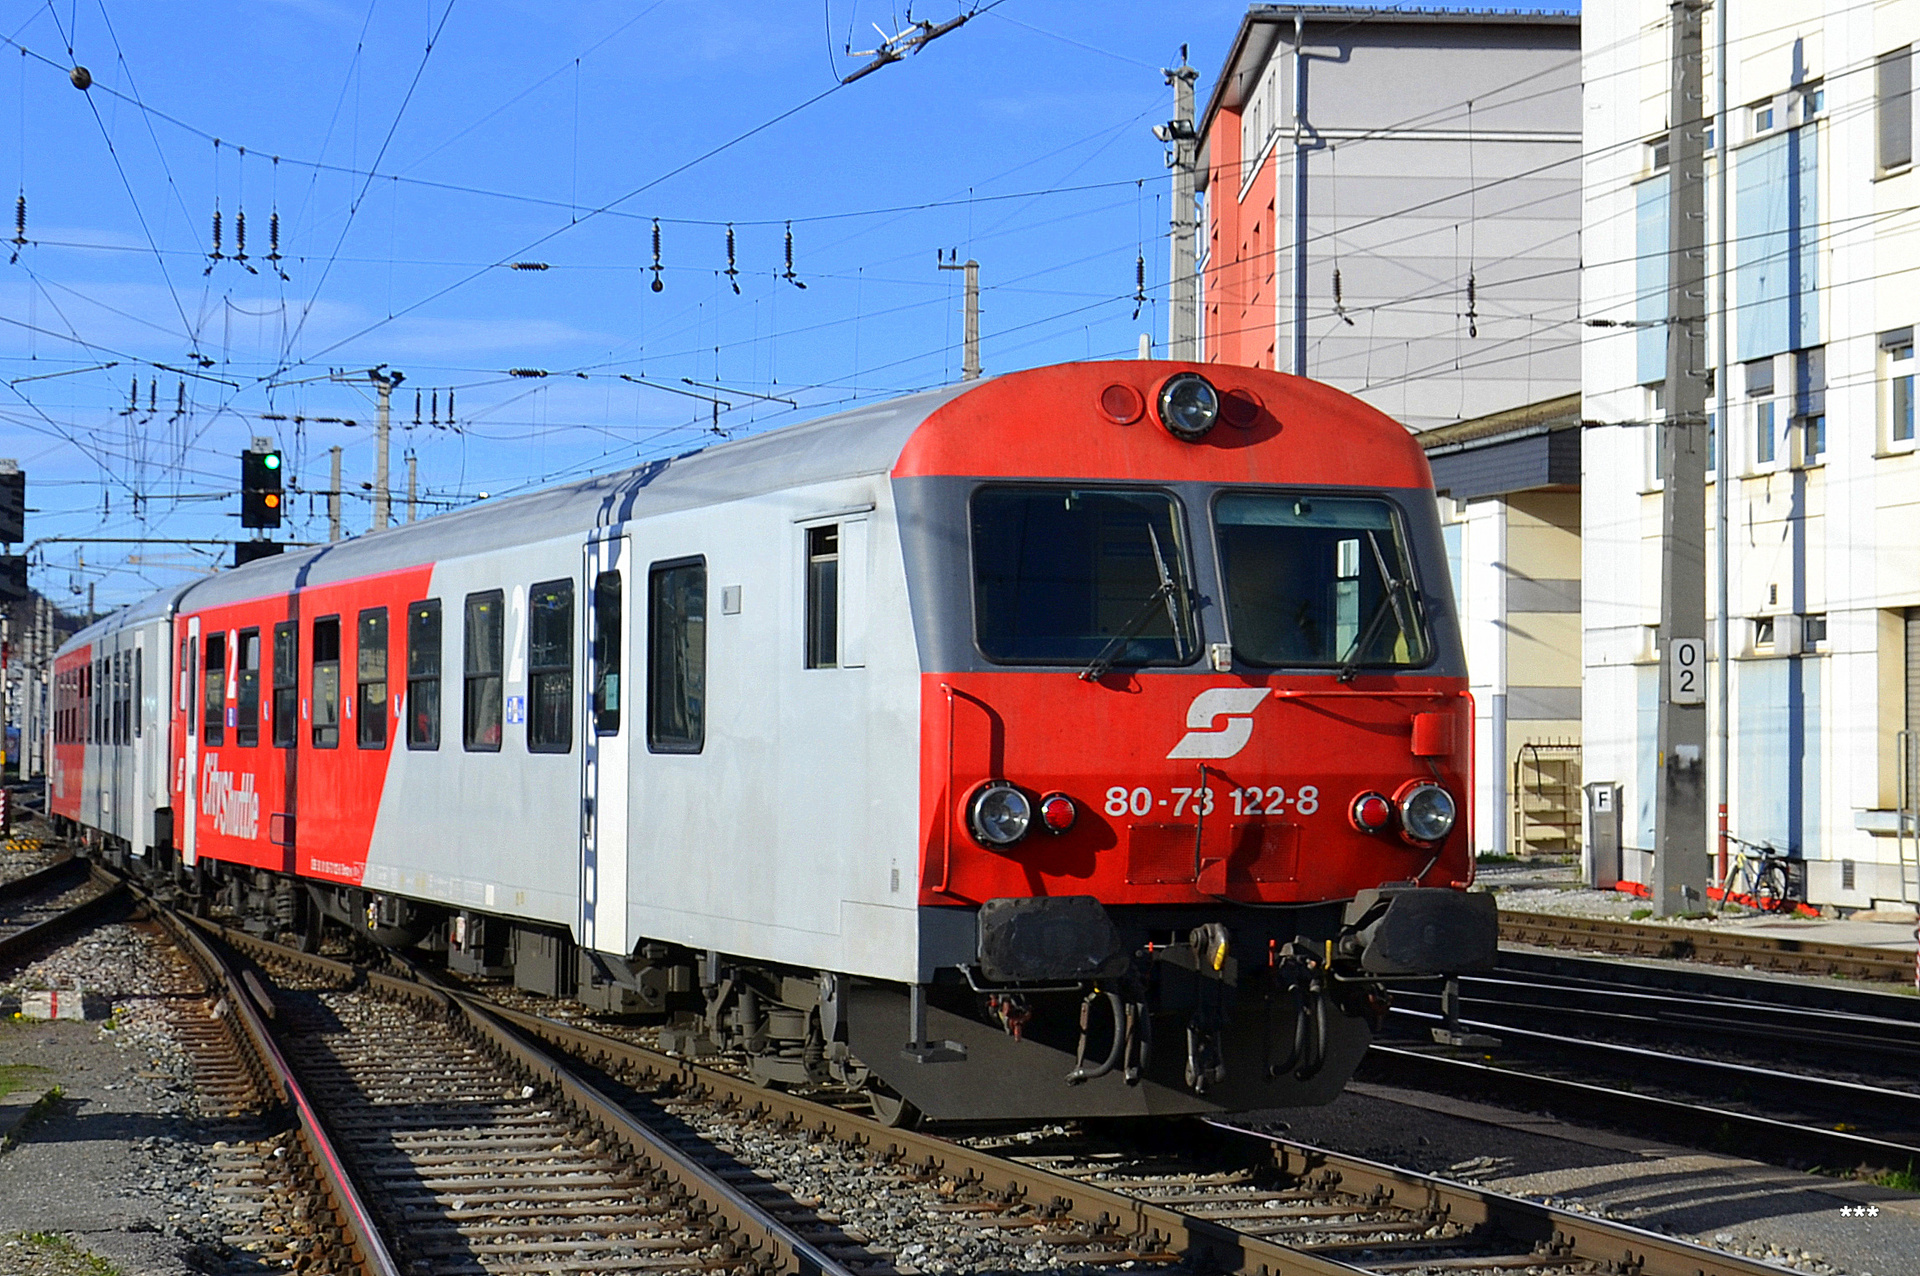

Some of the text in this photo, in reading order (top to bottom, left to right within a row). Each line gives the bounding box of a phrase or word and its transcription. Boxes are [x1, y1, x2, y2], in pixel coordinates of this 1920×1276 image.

[508, 584, 525, 682] 2
[227, 628, 238, 699] 2
[1680, 670, 1695, 692] 2
[1104, 785, 1319, 817] 80-73 122-8
[1598, 791, 1608, 807] F
